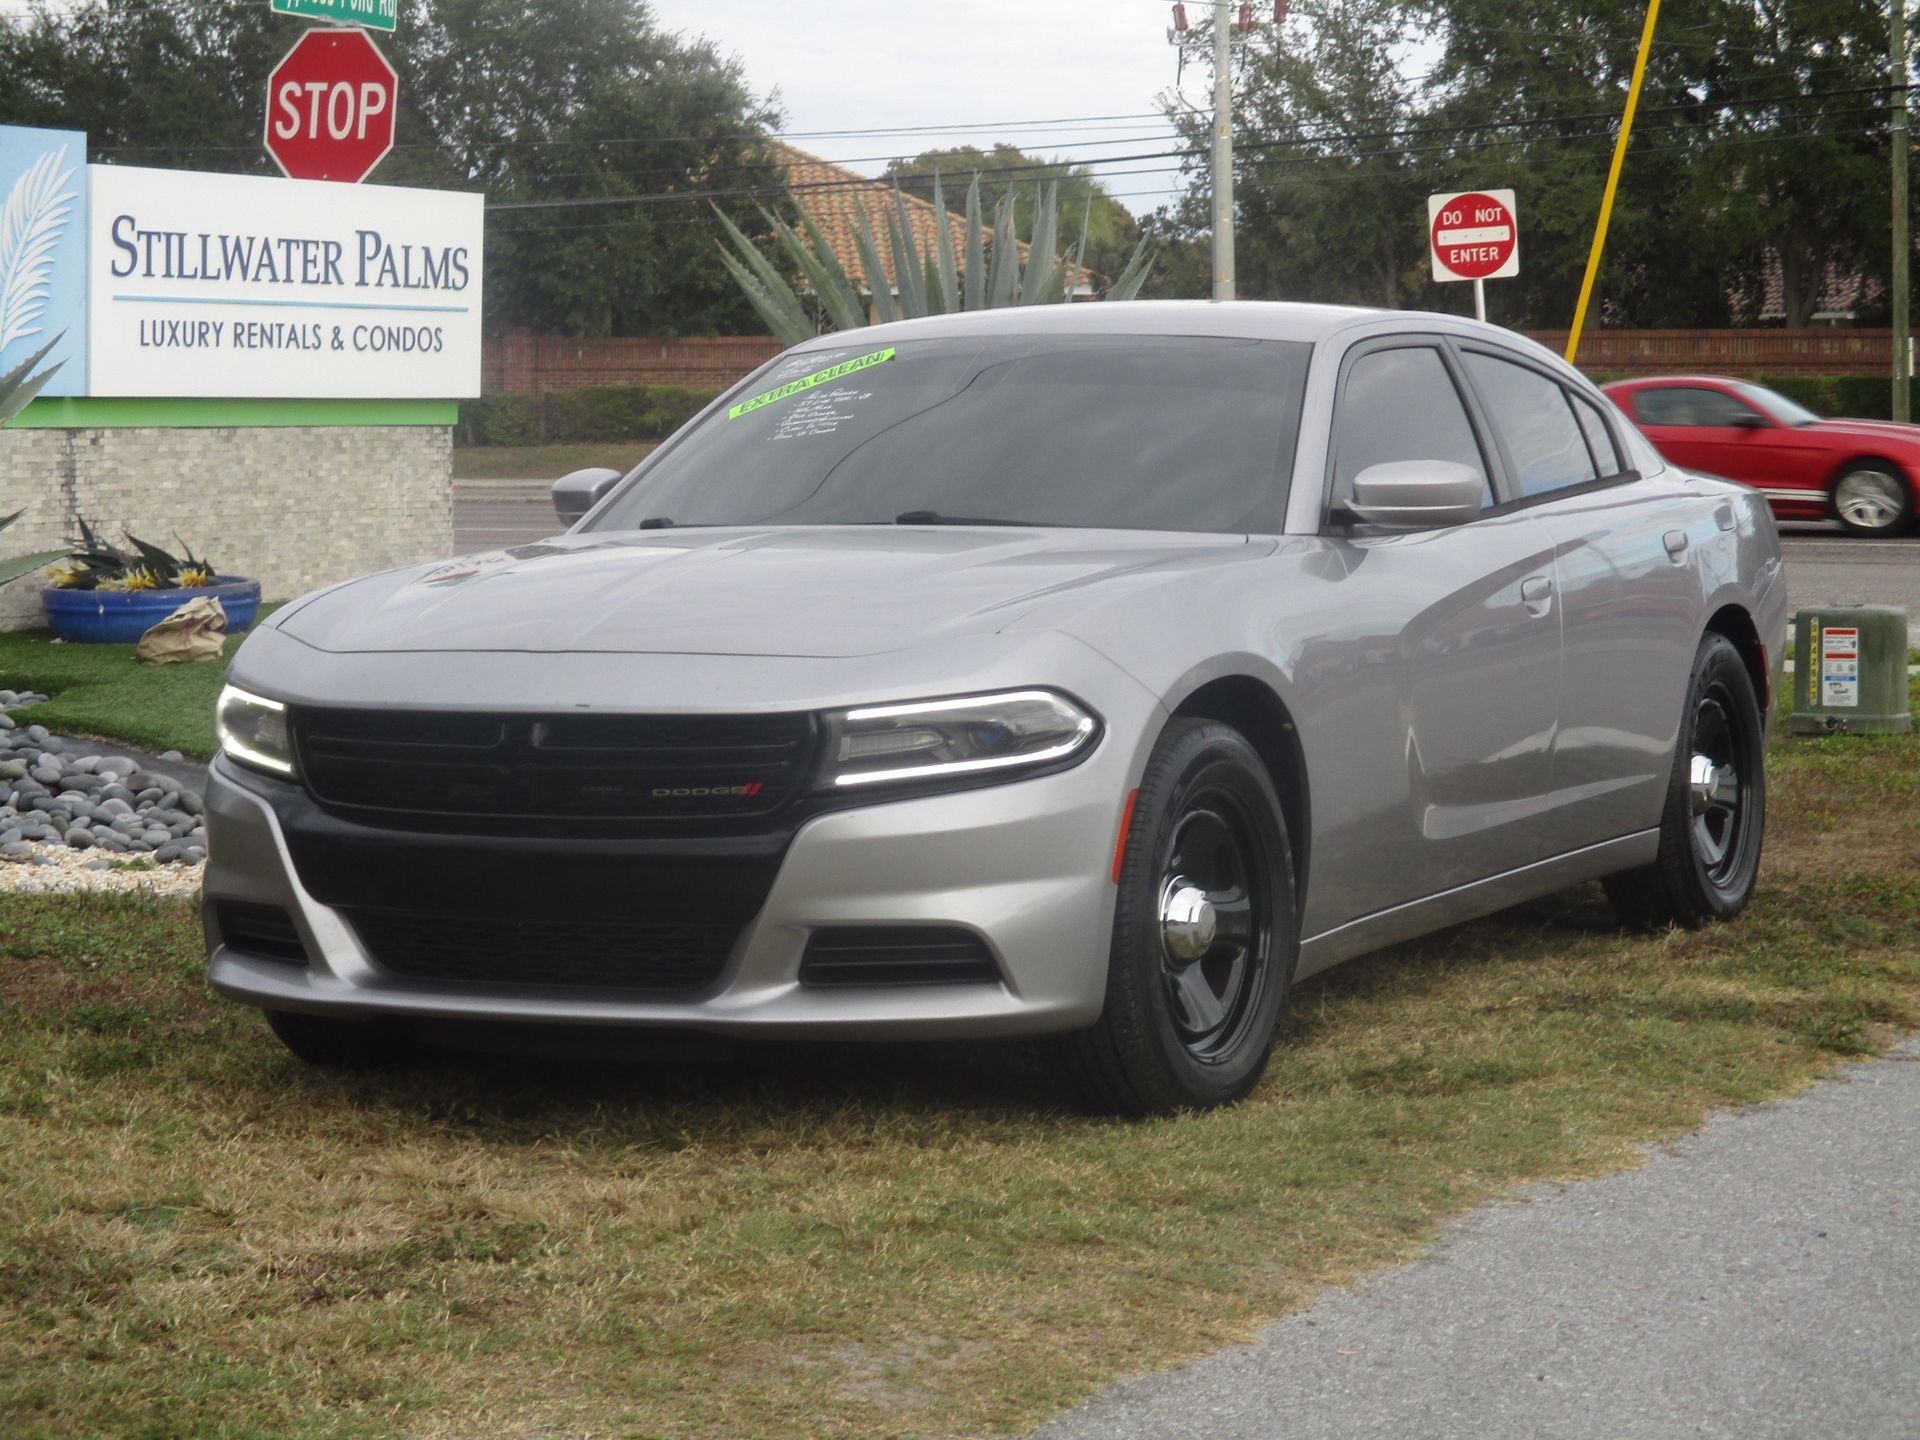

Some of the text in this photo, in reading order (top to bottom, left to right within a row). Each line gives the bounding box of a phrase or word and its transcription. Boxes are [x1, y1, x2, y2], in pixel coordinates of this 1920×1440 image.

[379, 0, 395, 17] Rd
[275, 82, 386, 140] STOP
[1443, 207, 1503, 225] DO NOT
[111, 214, 469, 291] STILLWATER PALMS
[1450, 246, 1500, 263] ENTER
[140, 319, 443, 352] LUXURY RENTALS & CONDOS
[738, 379, 808, 414] EXTRA
[652, 786, 747, 797] DODGE
